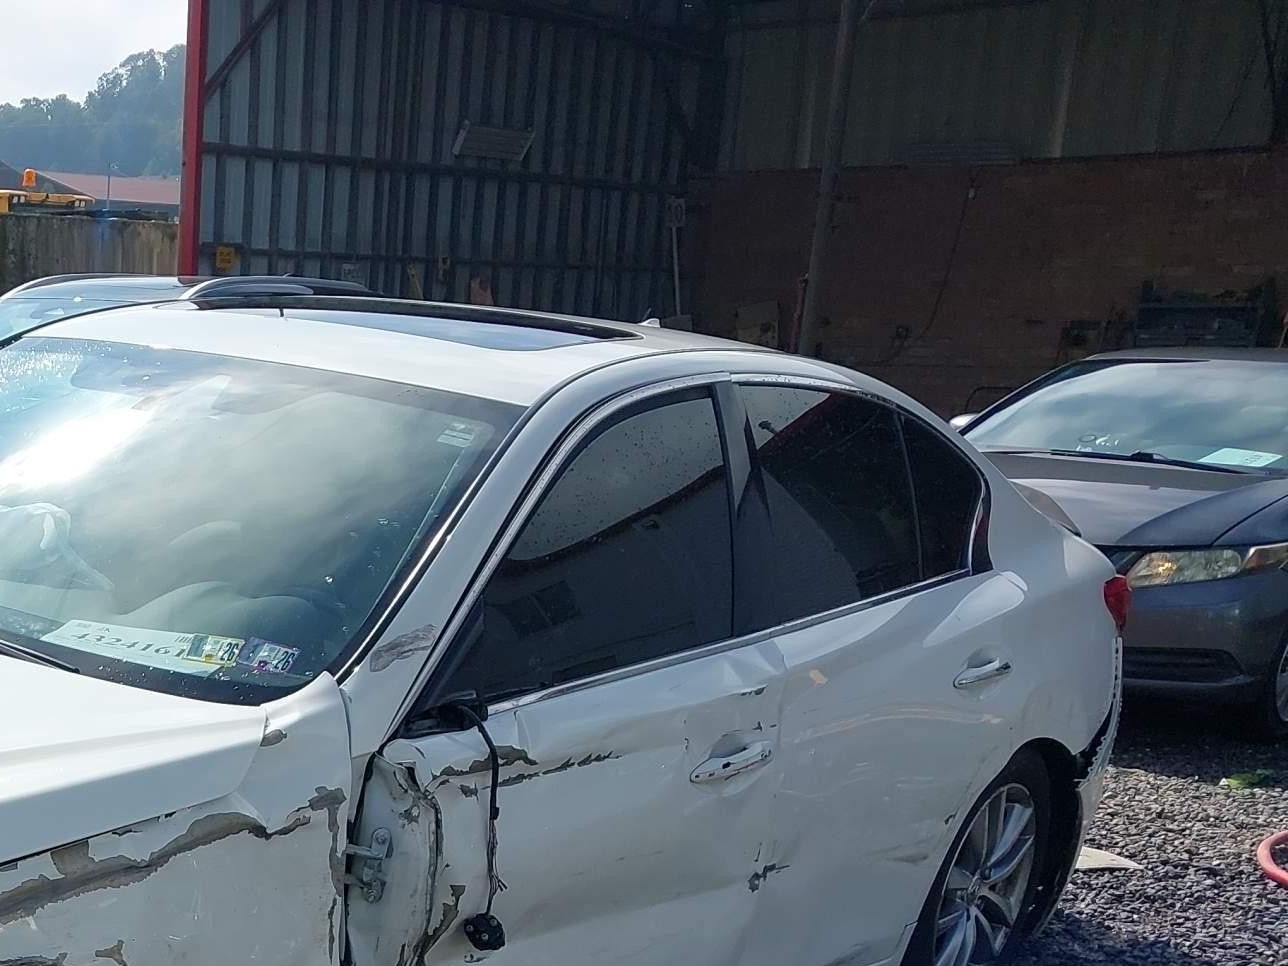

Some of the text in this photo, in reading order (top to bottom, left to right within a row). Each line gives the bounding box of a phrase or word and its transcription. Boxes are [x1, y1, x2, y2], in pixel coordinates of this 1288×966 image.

[71, 633, 187, 658] 4324161
[220, 642, 239, 662] 26
[275, 650, 295, 671] 26
